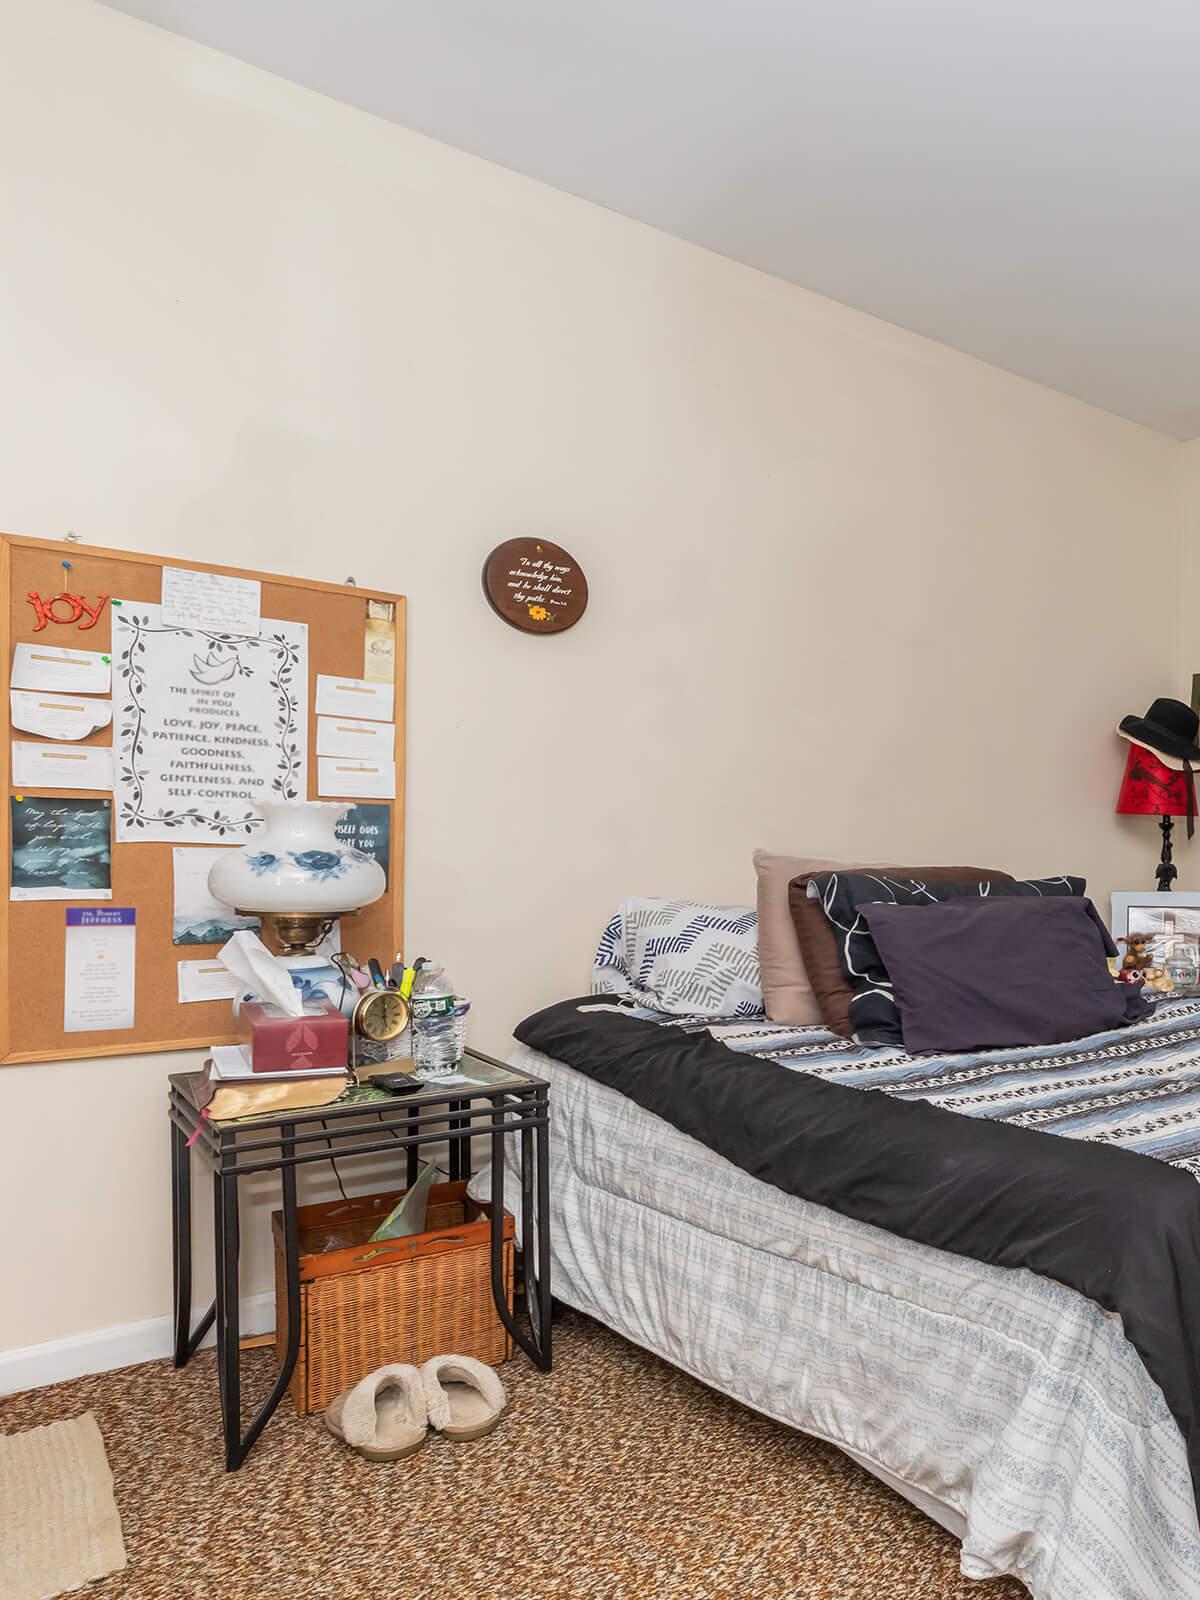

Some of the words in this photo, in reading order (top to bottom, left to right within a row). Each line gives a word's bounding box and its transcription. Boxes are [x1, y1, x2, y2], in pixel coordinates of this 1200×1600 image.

[543, 561, 554, 572] thy
[508, 569, 549, 582] acknowledge
[507, 580, 523, 588] and
[532, 583, 552, 592] shall
[552, 586, 572, 595] direct
[513, 591, 526, 602] thy
[169, 686, 188, 695] THE
[191, 688, 220, 697] SPIRIT
[223, 691, 236, 699] OF
[211, 699, 232, 707] YOU
[189, 706, 241, 717] PRODUCES
[238, 777, 265, 786] AND
[168, 788, 257, 800] SELF-CONTROL.
[358, 839, 375, 848] YOU
